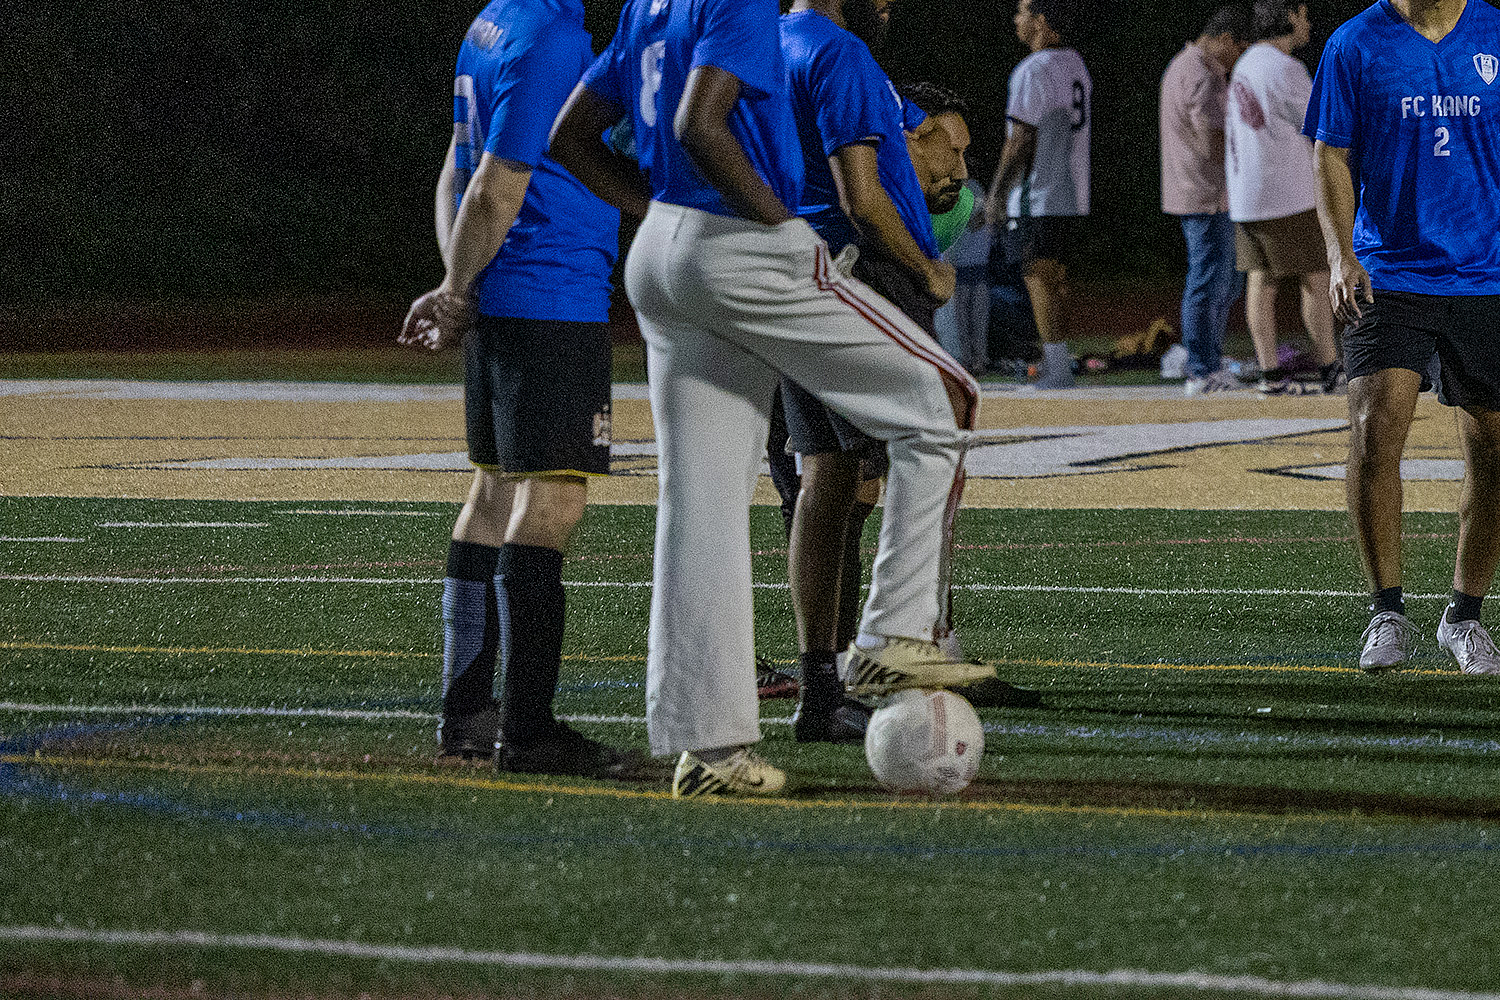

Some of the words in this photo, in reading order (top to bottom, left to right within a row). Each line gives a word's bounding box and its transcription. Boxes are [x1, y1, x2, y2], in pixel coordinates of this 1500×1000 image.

[1401, 95, 1426, 119] FC
[1431, 95, 1481, 117] KANG
[1433, 126, 1451, 157] 2
